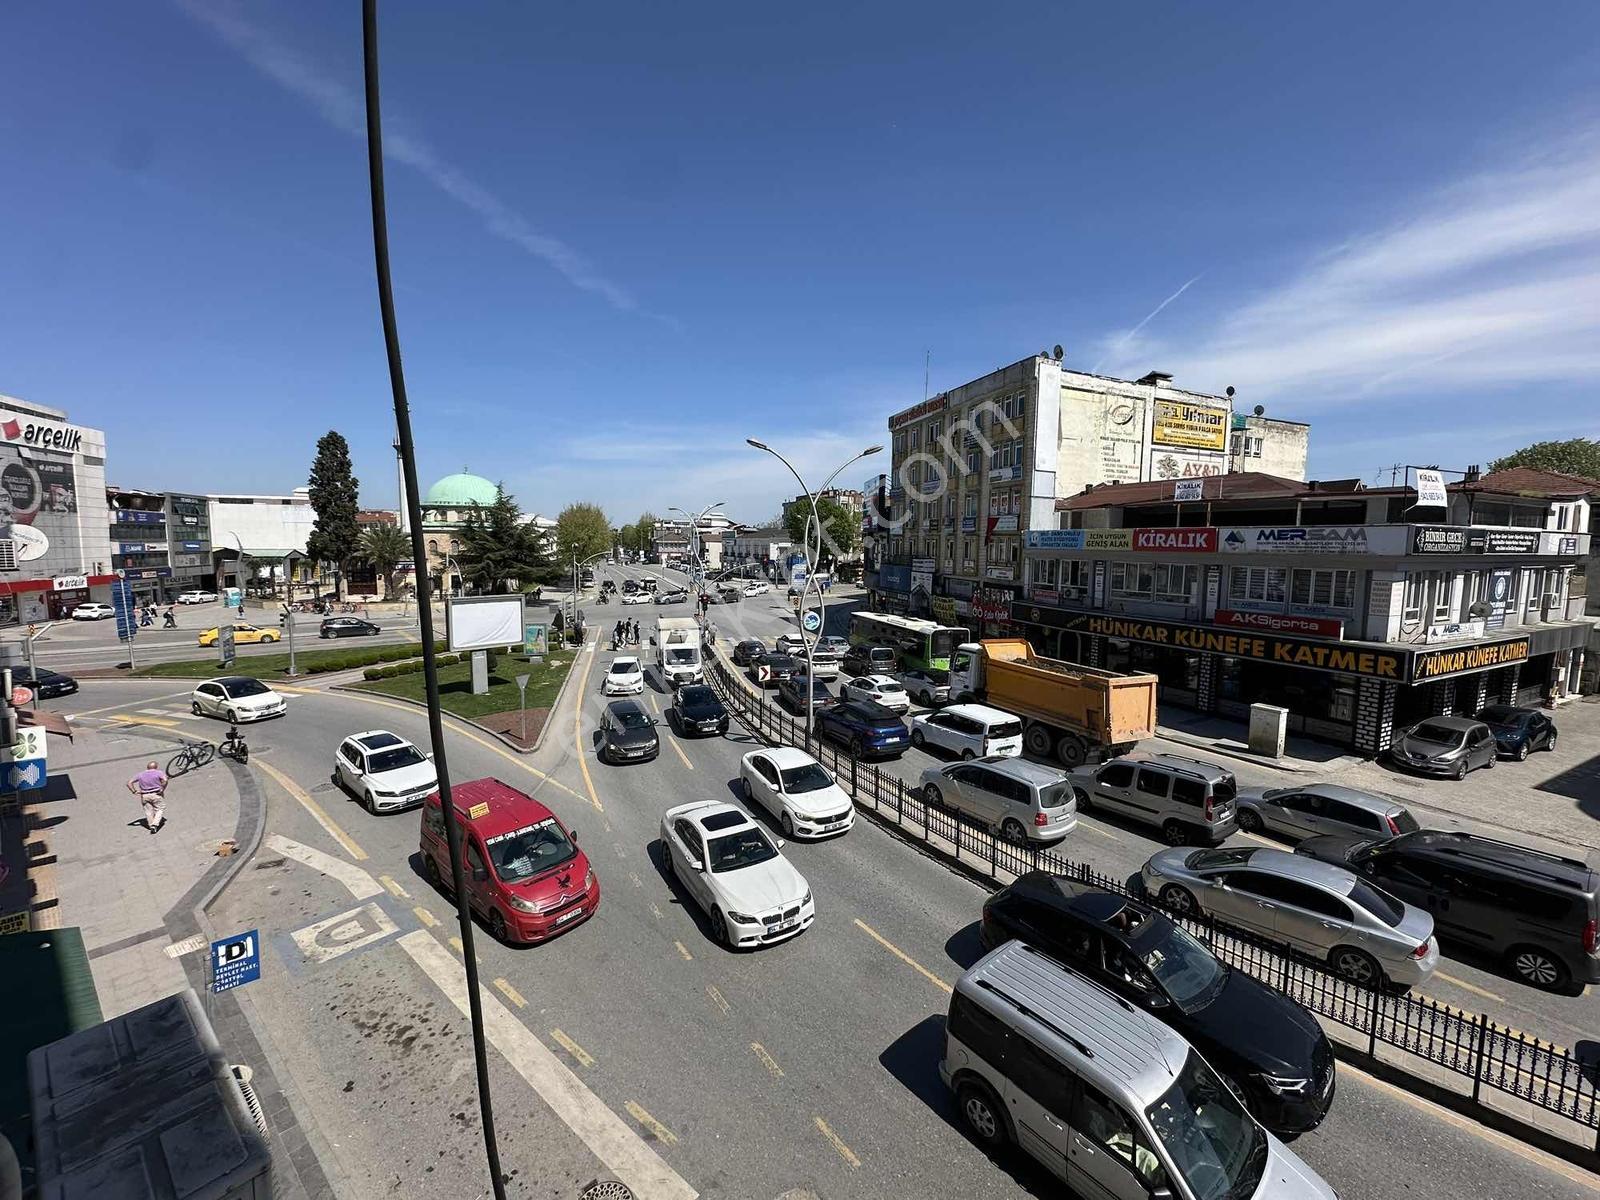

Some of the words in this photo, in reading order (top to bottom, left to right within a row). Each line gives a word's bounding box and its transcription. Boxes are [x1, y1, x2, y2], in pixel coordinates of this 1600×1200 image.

[24, 422, 82, 451] arçelik
[1109, 540, 1129, 548] ALAN
[1137, 529, 1208, 548] KİRALIK
[1256, 527, 1368, 541] MERSAM
[1088, 616, 1169, 644] HÜNKAR
[1174, 627, 1266, 658] KÜNEFE
[1274, 641, 1399, 677] KATMER
[1426, 652, 1465, 676] HÜNKAR
[1466, 646, 1499, 670] KÜNEFE
[1498, 641, 1528, 663] KATMER
